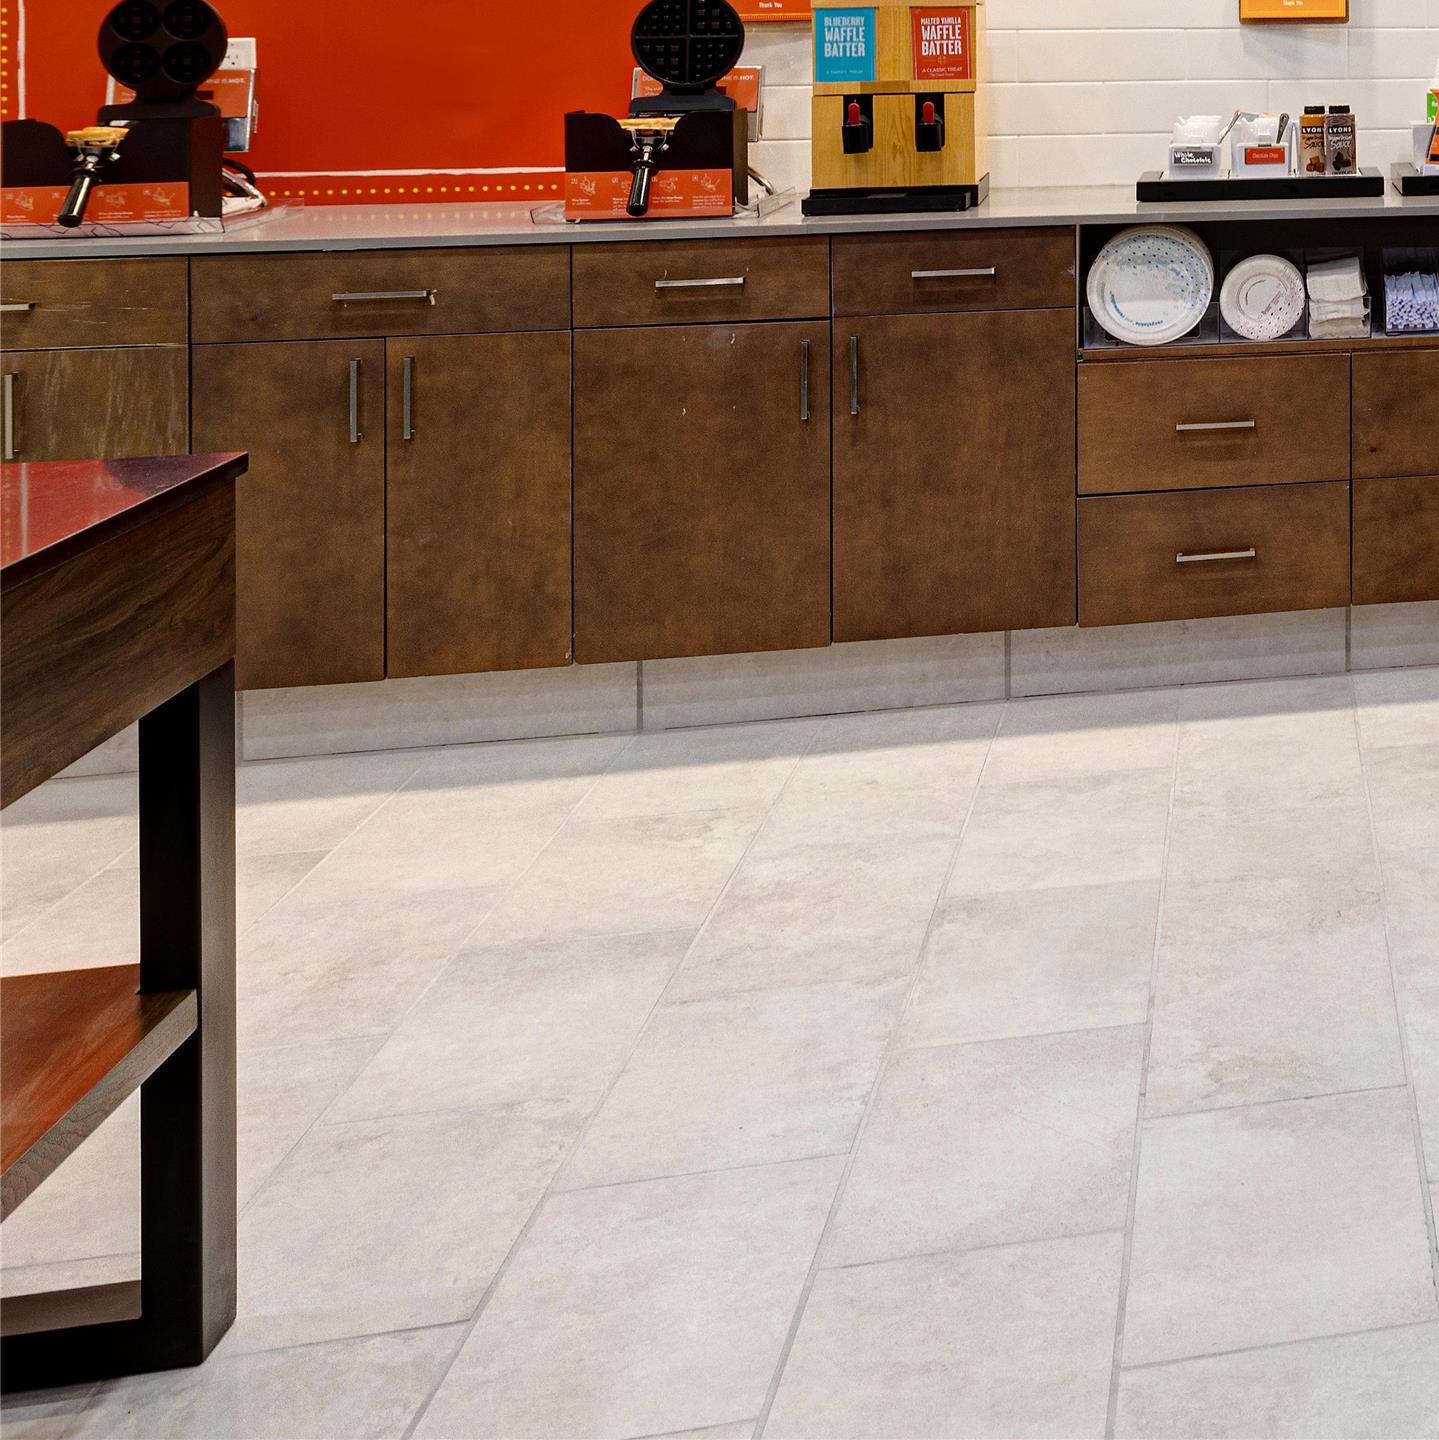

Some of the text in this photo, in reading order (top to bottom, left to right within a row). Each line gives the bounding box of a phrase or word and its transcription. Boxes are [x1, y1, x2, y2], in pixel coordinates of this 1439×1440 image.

[824, 16, 865, 26] BLUEBERRY
[824, 27, 865, 42] WAFFLE
[921, 25, 962, 40] WAFFLE
[824, 42, 865, 57] BATTER
[921, 40, 962, 55] BATTER
